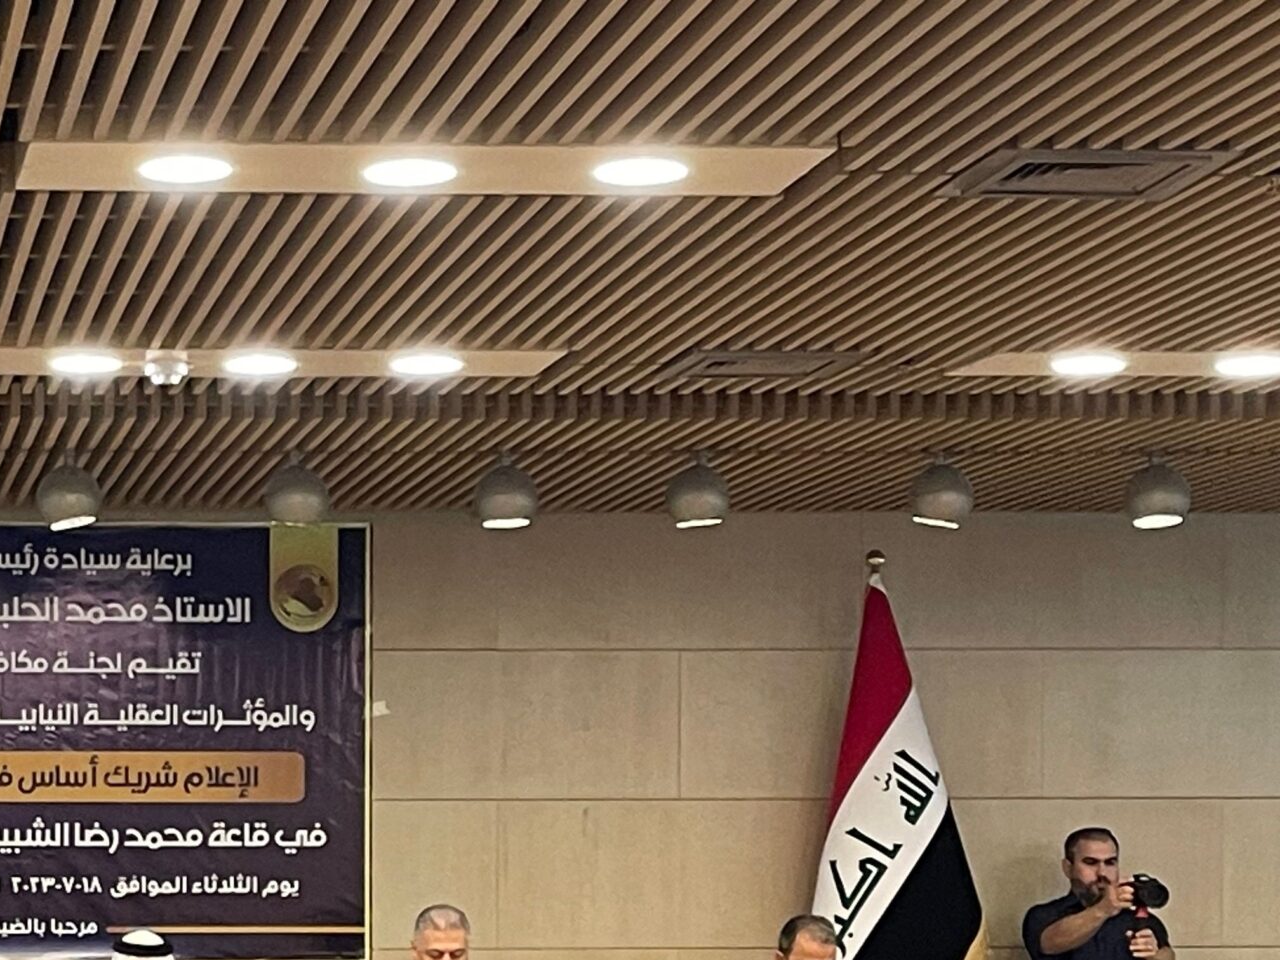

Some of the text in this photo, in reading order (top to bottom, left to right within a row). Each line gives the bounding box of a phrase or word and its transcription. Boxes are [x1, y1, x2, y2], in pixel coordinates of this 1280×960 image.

[43, 547, 121, 575] سيادة
[125, 547, 192, 576] برعاية
[65, 602, 148, 624] محمد
[152, 596, 251, 623] الاستاذ
[52, 650, 122, 679] لجنة
[127, 651, 202, 680] تقيم
[83, 702, 178, 731] العقلية
[182, 697, 316, 732] والمؤثرات
[17, 754, 98, 794] أساس
[103, 760, 178, 794] شريك
[183, 765, 259, 798] الإعلام
[73, 821, 120, 854] رضا
[123, 827, 203, 850] محمد
[207, 821, 271, 848] قاعة
[274, 822, 327, 854] في
[109, 873, 187, 898] الموافق
[191, 873, 258, 894] الثلاثاء
[261, 878, 300, 898] يوم
[50, 917, 99, 938] مرحبا
